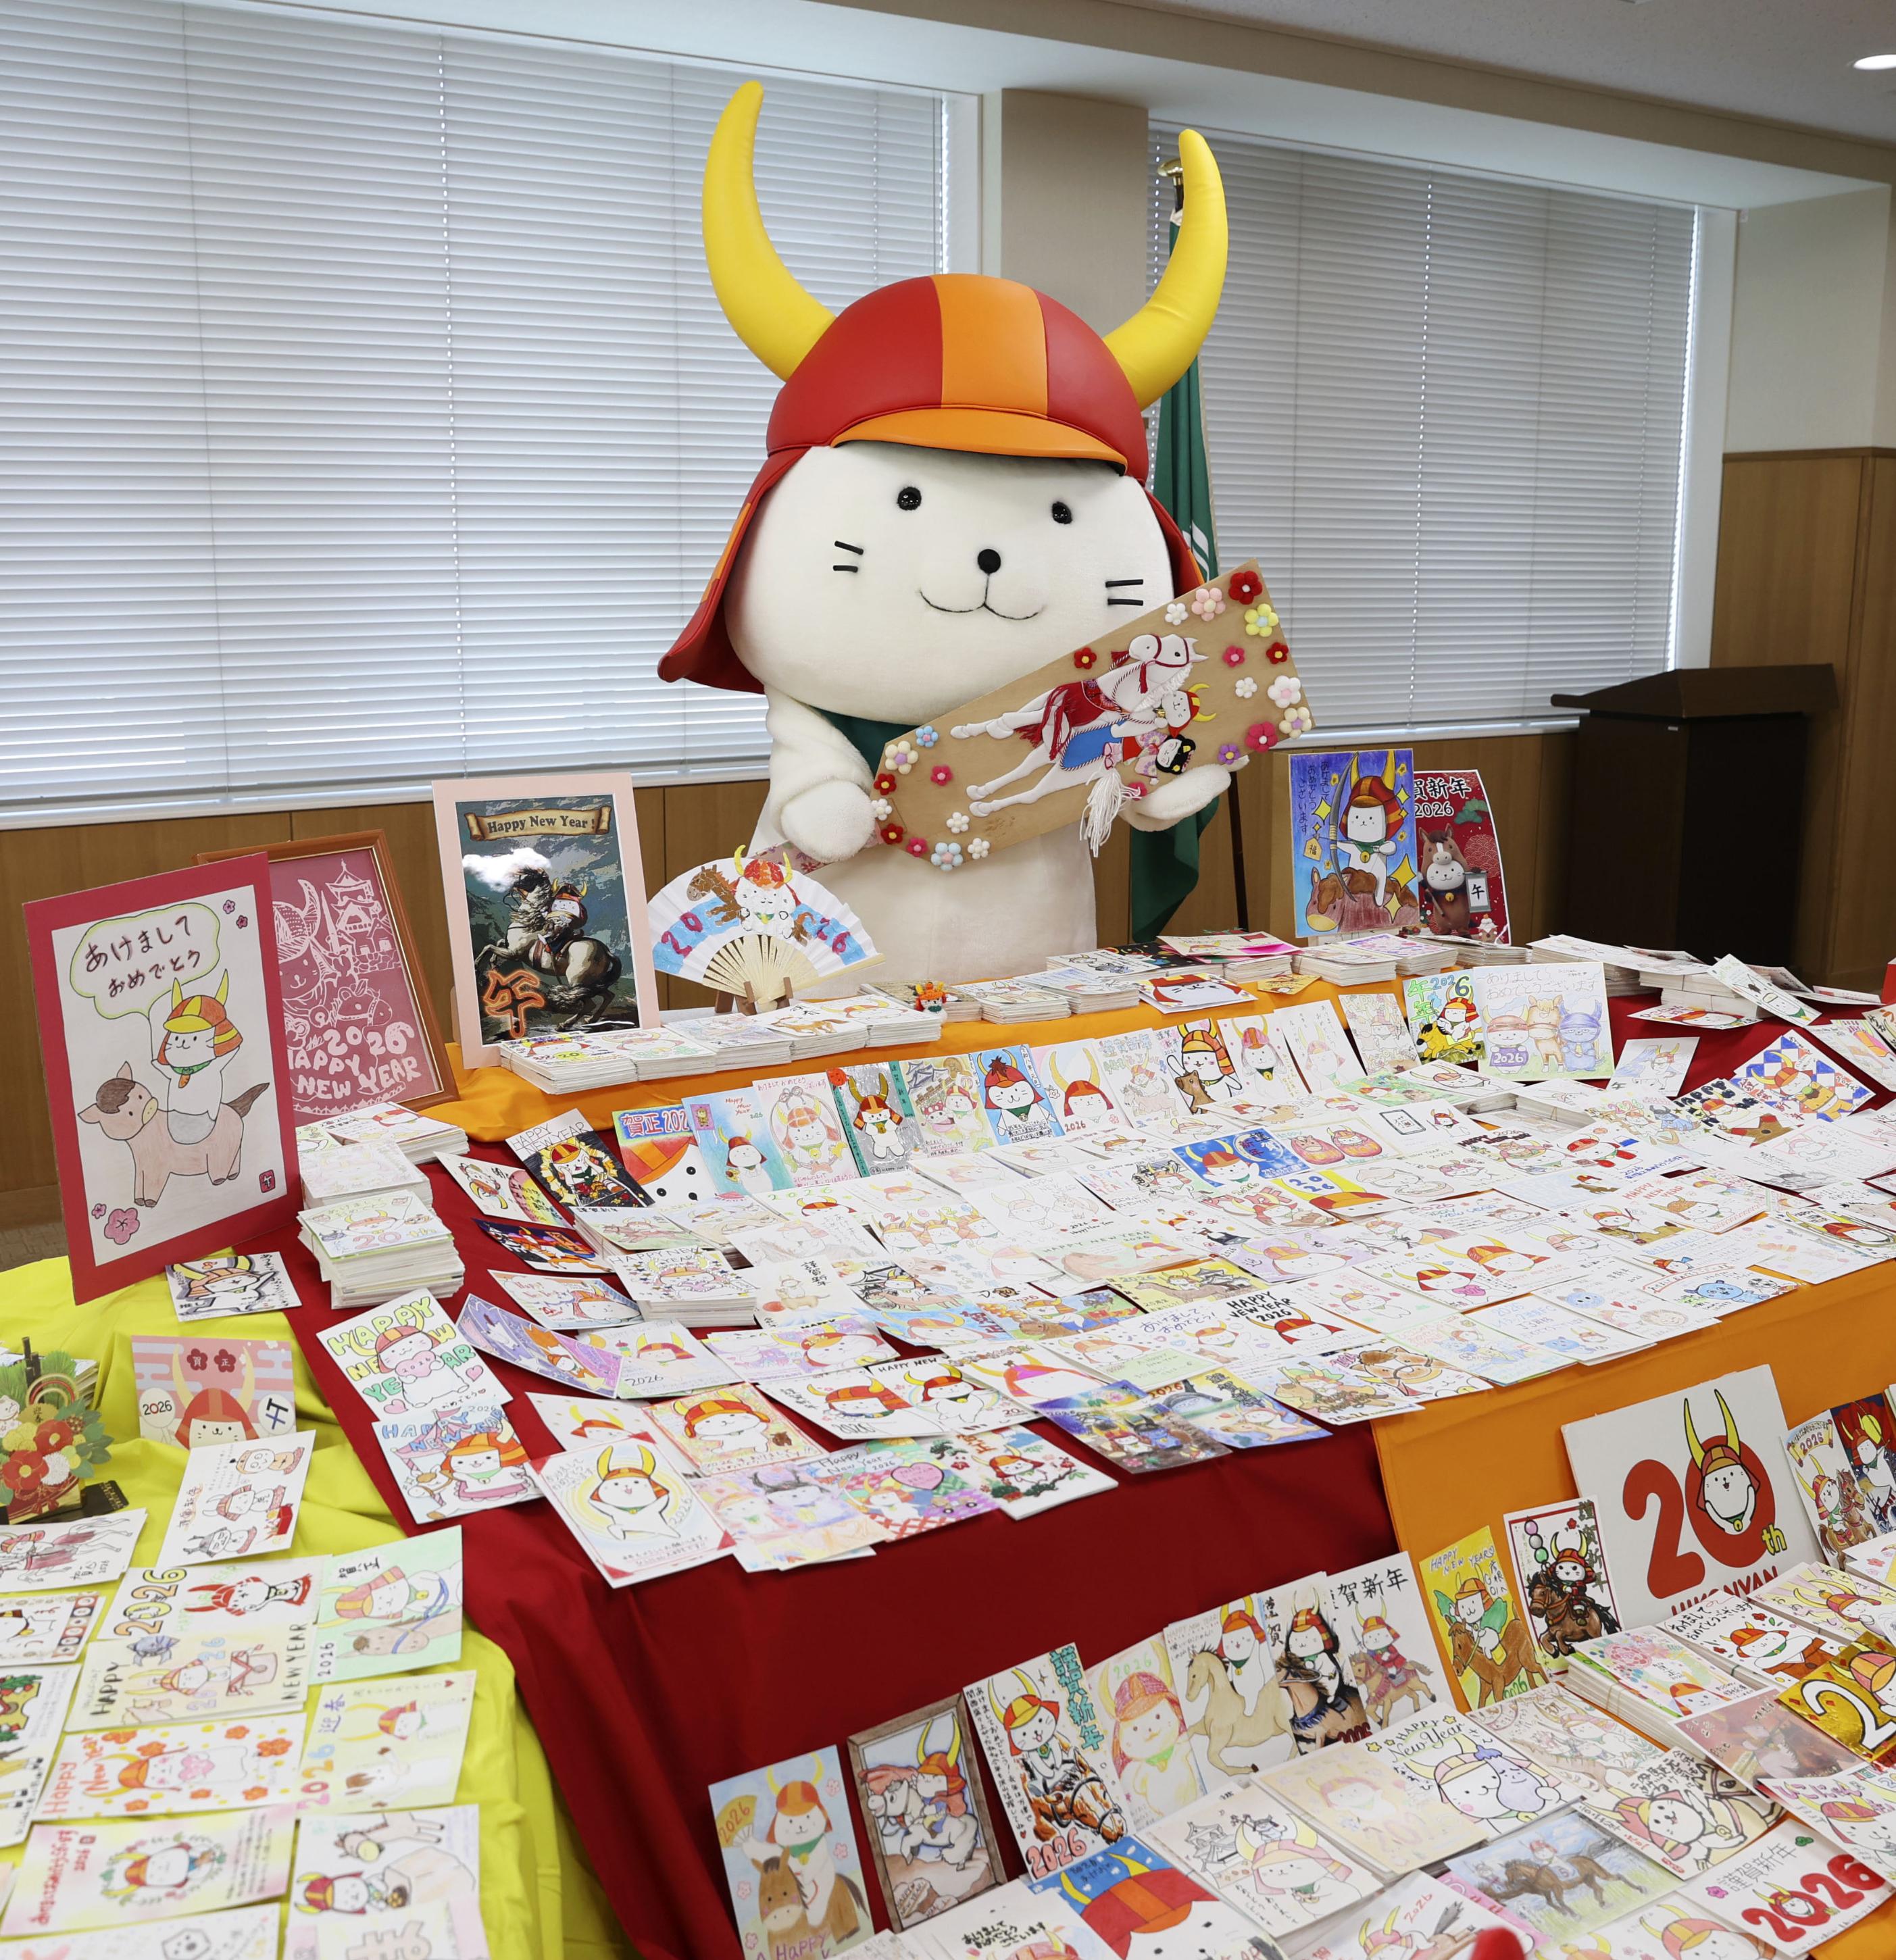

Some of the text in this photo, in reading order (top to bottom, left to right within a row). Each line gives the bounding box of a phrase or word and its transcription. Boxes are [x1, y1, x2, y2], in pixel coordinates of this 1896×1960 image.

[1307, 765, 1317, 810] おめでとう
[1320, 761, 1329, 800] あけまして
[1298, 777, 1307, 835] ございます
[1415, 802, 1454, 817] 2026
[487, 819, 526, 834] Happy
[530, 815, 557, 828] New
[559, 815, 588, 828] Year
[1470, 883, 1485, 900] 午
[85, 915, 191, 972] あけまして
[108, 949, 201, 998] おめでとう
[1487, 968, 1543, 986] あけまして
[1430, 975, 1470, 997] 2026
[1487, 980, 1599, 1000] おめでとうございます
[484, 969, 545, 1039] 午
[323, 1022, 414, 1056] 2026
[1494, 1053, 1524, 1064] 2026
[297, 1056, 422, 1100] NEW YEAR
[512, 1123, 551, 1149] HAPPY
[622, 1113, 660, 1136] 賀正
[1064, 1122, 1087, 1132] 2026
[526, 1122, 589, 1156] NEW YEAR
[768, 1188, 832, 1201] 2026
[1622, 1182, 1653, 1200] HAPPY
[609, 1246, 700, 1264] HAPPY NEW
[1043, 1242, 1083, 1253] HAPPY
[1090, 1236, 1116, 1244] NEW
[1221, 1247, 1237, 1258] 2026
[1226, 1291, 1278, 1309] HAPPY
[1261, 1298, 1297, 1311] YEAR
[327, 1297, 434, 1356] HAPPY
[1141, 1308, 1200, 1333] あけまして
[1256, 1310, 1293, 1322] 2026
[193, 1356, 231, 1368] 賀正
[363, 1345, 476, 1402] YEAR
[402, 1356, 431, 1374] 2026
[878, 1357, 938, 1373] HAPPY NEW
[624, 1374, 665, 1386] 2026
[1148, 1382, 1183, 1399] 2026
[142, 1401, 173, 1417] 2026
[382, 1411, 469, 1439] HAPPY
[1799, 1432, 1825, 1455] 2026
[818, 1451, 859, 1467] Happy
[862, 1456, 882, 1467] Year
[872, 1460, 895, 1470] 2026
[1430, 1549, 1458, 1572] HAPPY
[1443, 1551, 1490, 1575] NEW YEAR
[114, 1567, 187, 1636] 2026
[1671, 1565, 1779, 1617] NYAN
[1668, 1607, 1712, 1634] あけまして
[1687, 1600, 1754, 1640] おめでとうございます
[280, 1623, 308, 1701] NEW YEAR
[318, 1642, 336, 1678] 2026
[90, 1660, 130, 1717] HAPPY
[1396, 1719, 1441, 1741] HAPPY
[1387, 1722, 1466, 1765] New Year
[42, 1761, 78, 1815] Happy
[80, 1763, 109, 1792] New
[720, 1803, 752, 1844] 2026
[1026, 1826, 1087, 1880] 2026
[1716, 1842, 1797, 1892] 謹賀新年
[1403, 1892, 1433, 1925] 2026
[1741, 1854, 1887, 1943] 2026
[962, 1920, 1007, 1944] あけまして
